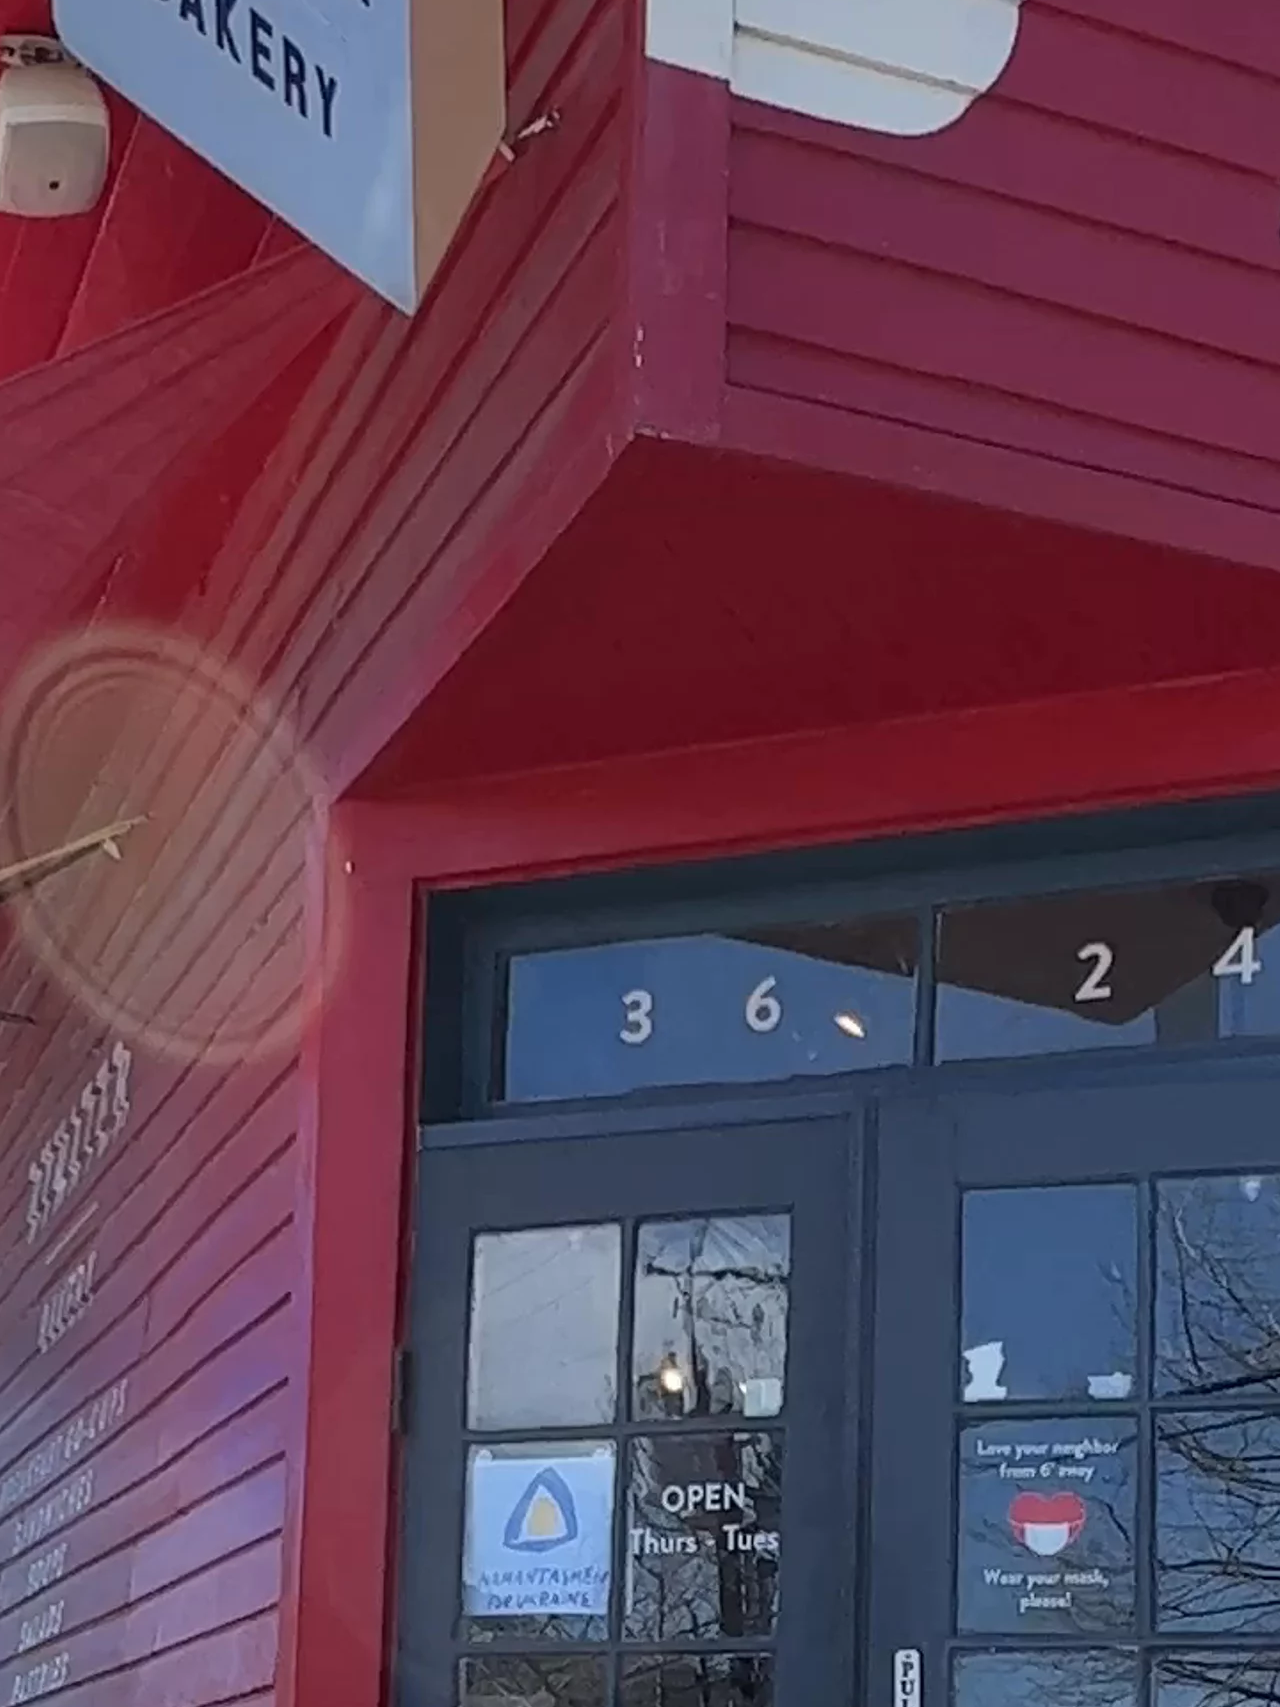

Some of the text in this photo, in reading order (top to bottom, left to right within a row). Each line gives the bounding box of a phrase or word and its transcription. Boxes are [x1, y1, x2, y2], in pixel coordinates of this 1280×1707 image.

[1014, 1443, 1049, 1461] your
[1051, 1437, 1120, 1460] neighbor
[999, 1462, 1037, 1478] from
[661, 1481, 745, 1513] OPEN
[628, 1527, 698, 1555] Thurs
[722, 1524, 780, 1551] Tues
[983, 1568, 1024, 1585] Wear
[1026, 1573, 1061, 1591] your
[1020, 1592, 1072, 1613] please!
